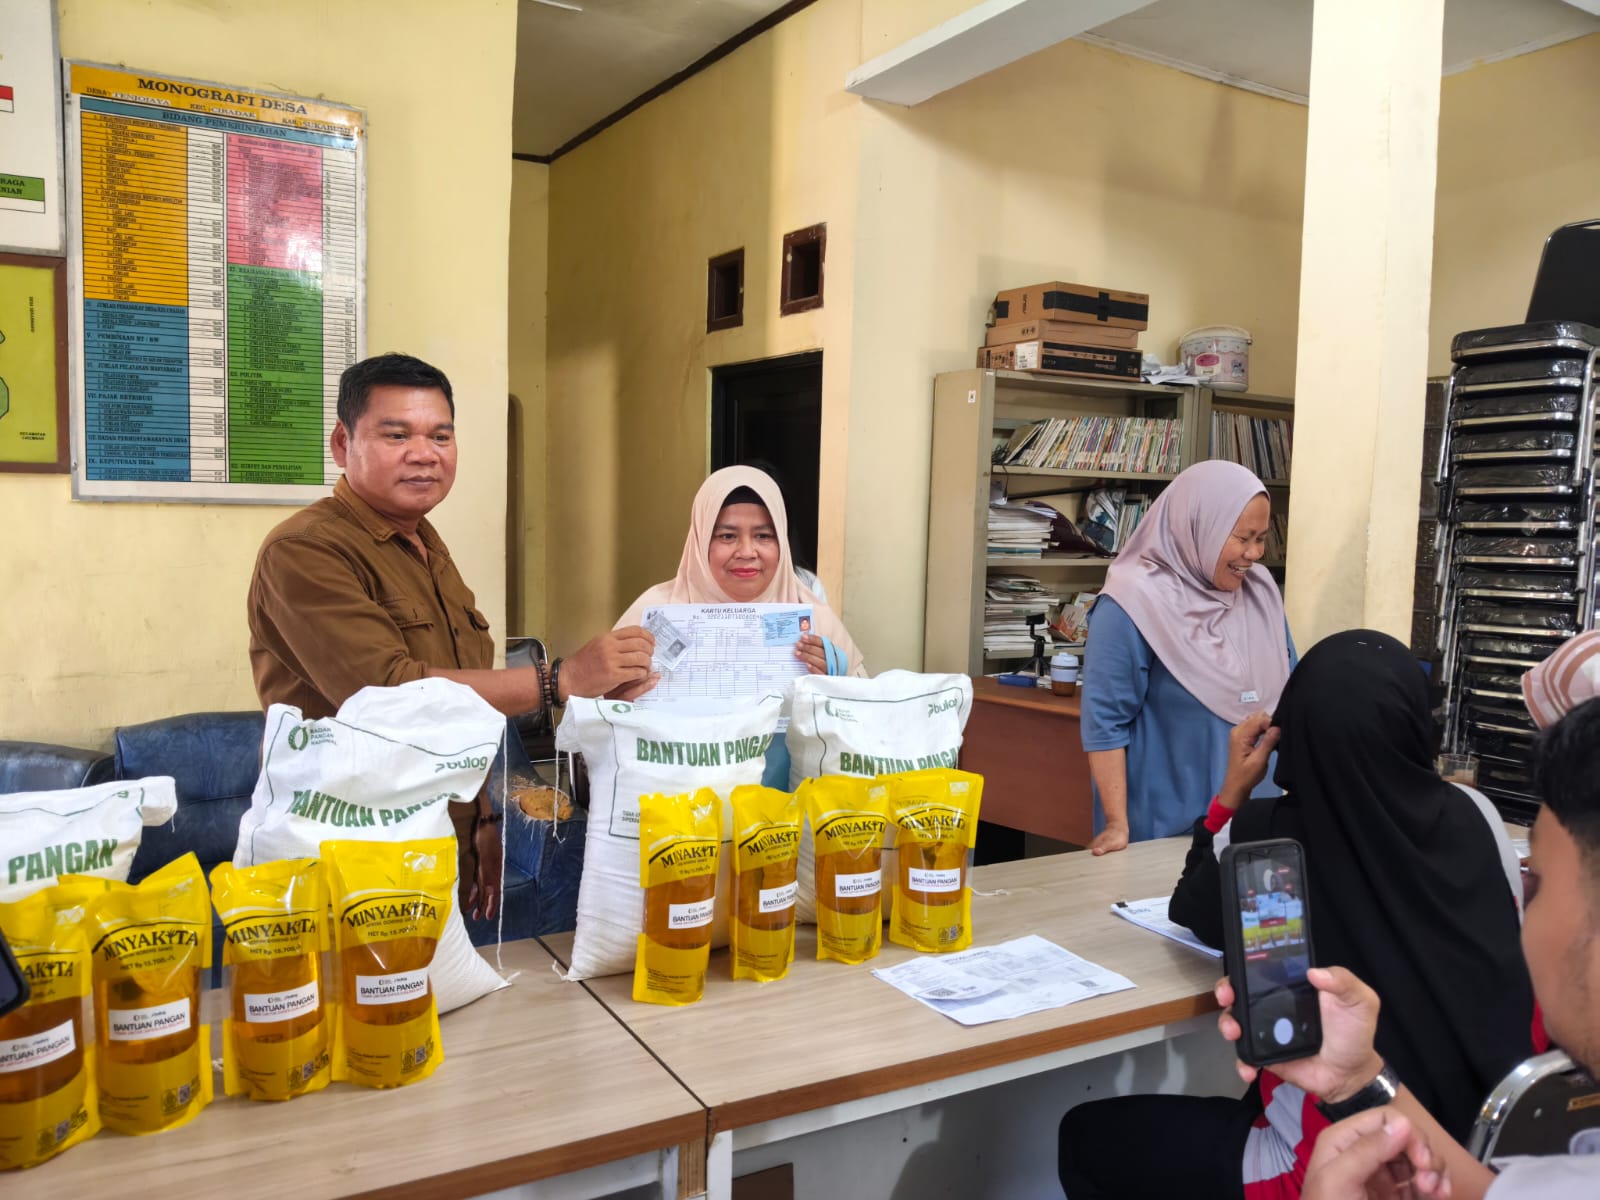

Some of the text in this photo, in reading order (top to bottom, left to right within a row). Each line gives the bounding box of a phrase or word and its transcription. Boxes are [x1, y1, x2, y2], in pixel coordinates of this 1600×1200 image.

[138, 79, 308, 115] MONOGRAFI DESA
[162, 111, 287, 137] BIDANG PEMERINTAHAN
[636, 737, 721, 767] BANTUAN
[918, 745, 961, 770] PANGA
[8, 838, 118, 885] PANGAN
[361, 980, 425, 995] BANTUAN PANGAN
[249, 1001, 285, 1013] BANTUAN
[287, 993, 315, 1008] PANGAN
[113, 1020, 153, 1032] BANTUAN
[154, 1012, 186, 1027] PANGAN
[36, 1036, 70, 1056] PANGAN
